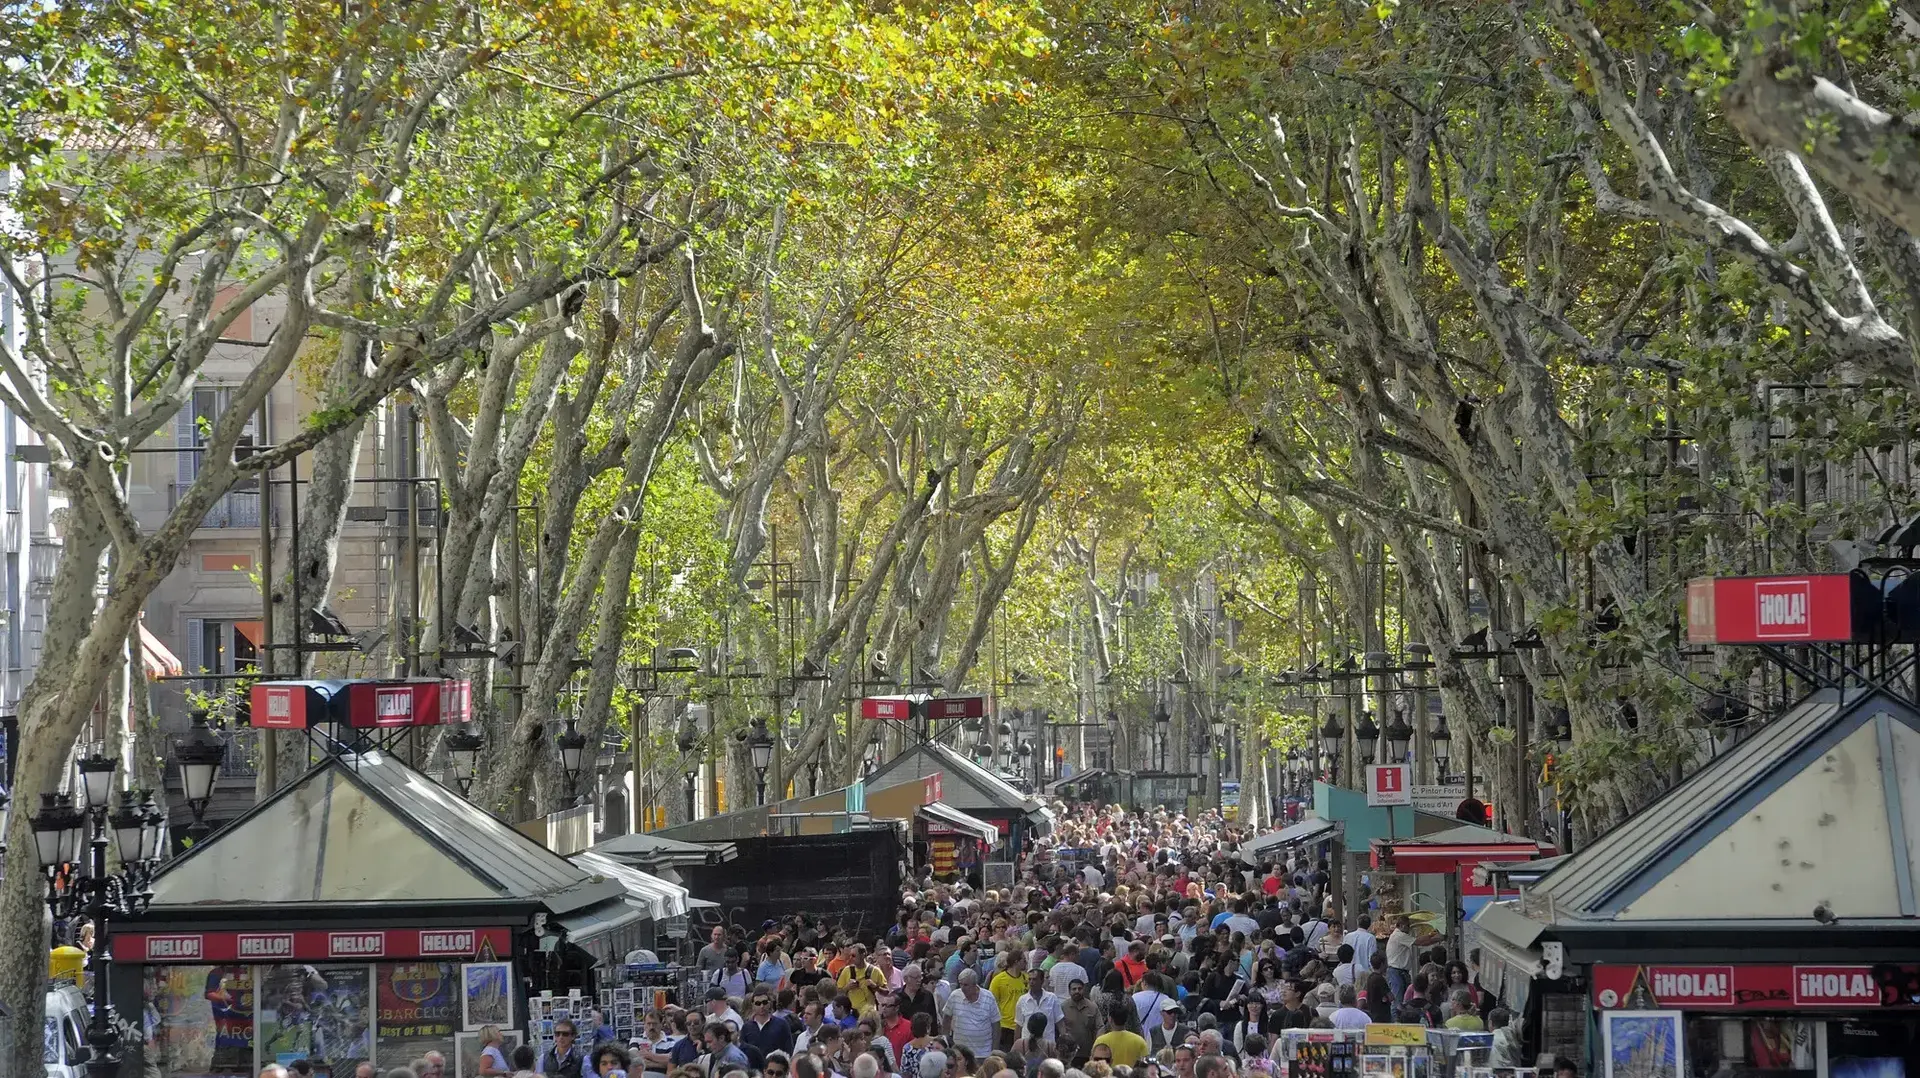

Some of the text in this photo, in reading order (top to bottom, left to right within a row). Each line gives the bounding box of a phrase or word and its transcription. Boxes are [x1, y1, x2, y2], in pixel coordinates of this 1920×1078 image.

[1760, 593, 1806, 625] ¡HOLA!
[378, 692, 411, 717] HELLO!
[1421, 787, 1442, 795] Pintor
[150, 939, 198, 956] HELLO!
[241, 937, 290, 954] HELLO!
[332, 936, 381, 952] HELLO!
[423, 934, 471, 950] HELLO!
[1654, 973, 1727, 997] ¡HOLA!
[1801, 973, 1875, 998] ¡HOLA!
[418, 1025, 433, 1036] THE
